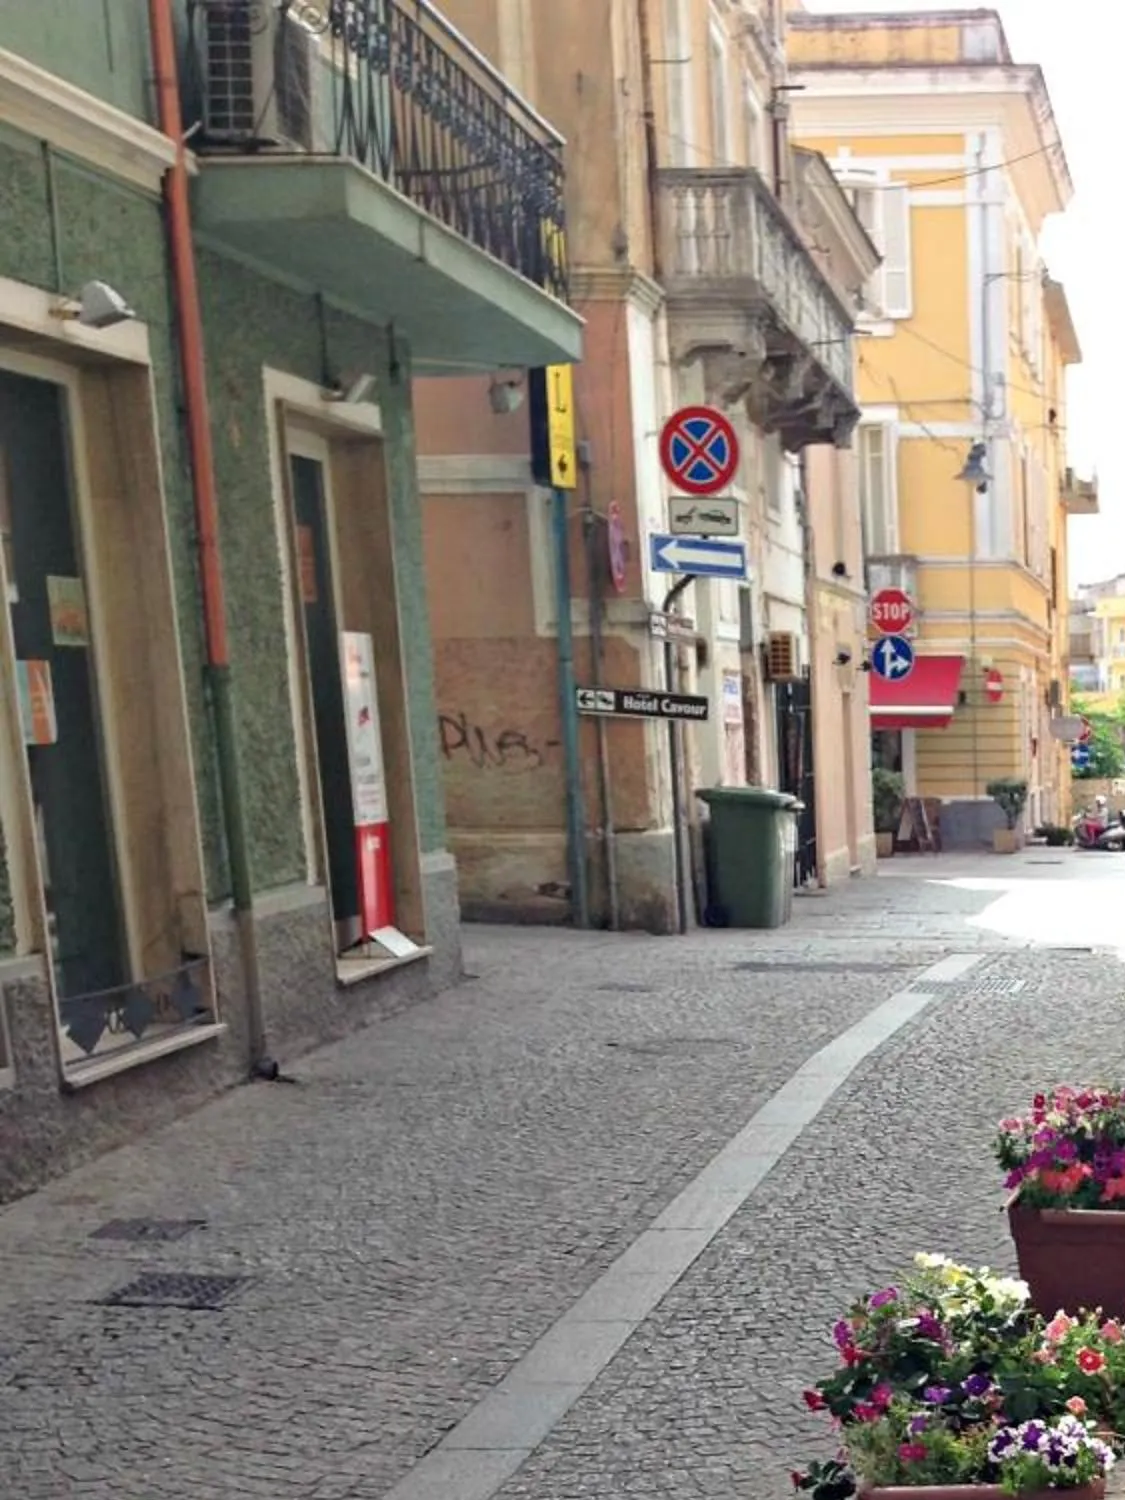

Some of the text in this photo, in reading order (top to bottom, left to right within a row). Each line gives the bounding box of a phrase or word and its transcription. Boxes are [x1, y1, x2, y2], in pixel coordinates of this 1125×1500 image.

[873, 602, 909, 620] STOP
[623, 695, 706, 717] Hotel Cavour
